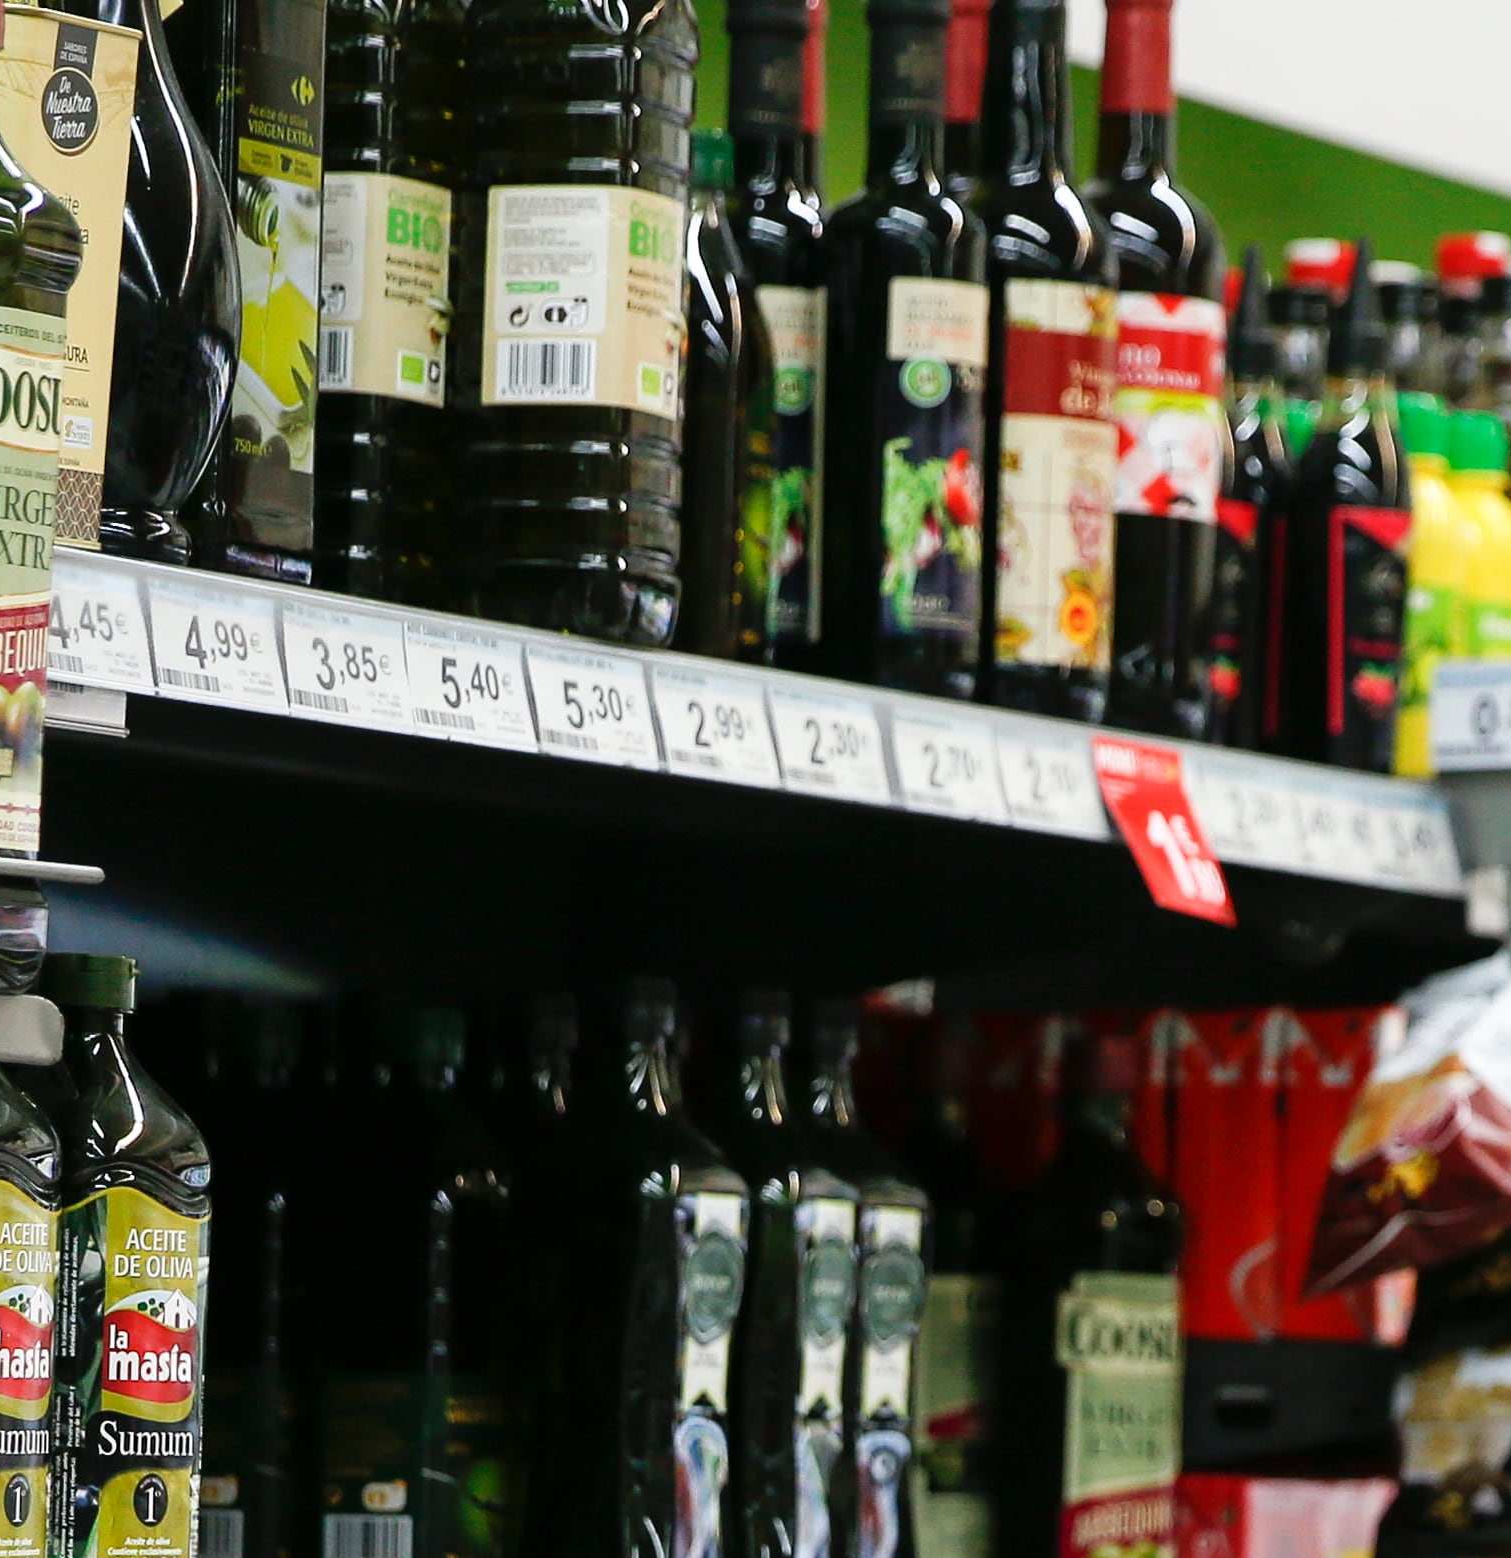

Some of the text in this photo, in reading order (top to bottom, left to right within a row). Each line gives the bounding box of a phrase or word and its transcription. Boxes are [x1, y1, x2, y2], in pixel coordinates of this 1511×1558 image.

[59, 75, 72, 94] De
[44, 91, 93, 115] Nuestra
[51, 115, 87, 140] Tierra
[247, 118, 315, 149] VIRGEN EXTRA
[387, 206, 444, 255] BIO
[63, 344, 90, 365] URA
[184, 614, 264, 670] 4,99€
[310, 635, 392, 692] 3,85€
[439, 656, 514, 711] 5,40€
[562, 679, 638, 730] 5,30€
[0, 1221, 49, 1248] ACEITE
[125, 1227, 187, 1253] ACEITE
[16, 1250, 53, 1274] OLIVA
[114, 1253, 194, 1280] DE OLIVA
[108, 1323, 129, 1350] la
[107, 1343, 192, 1384] masía
[97, 1420, 195, 1458] Sumum
